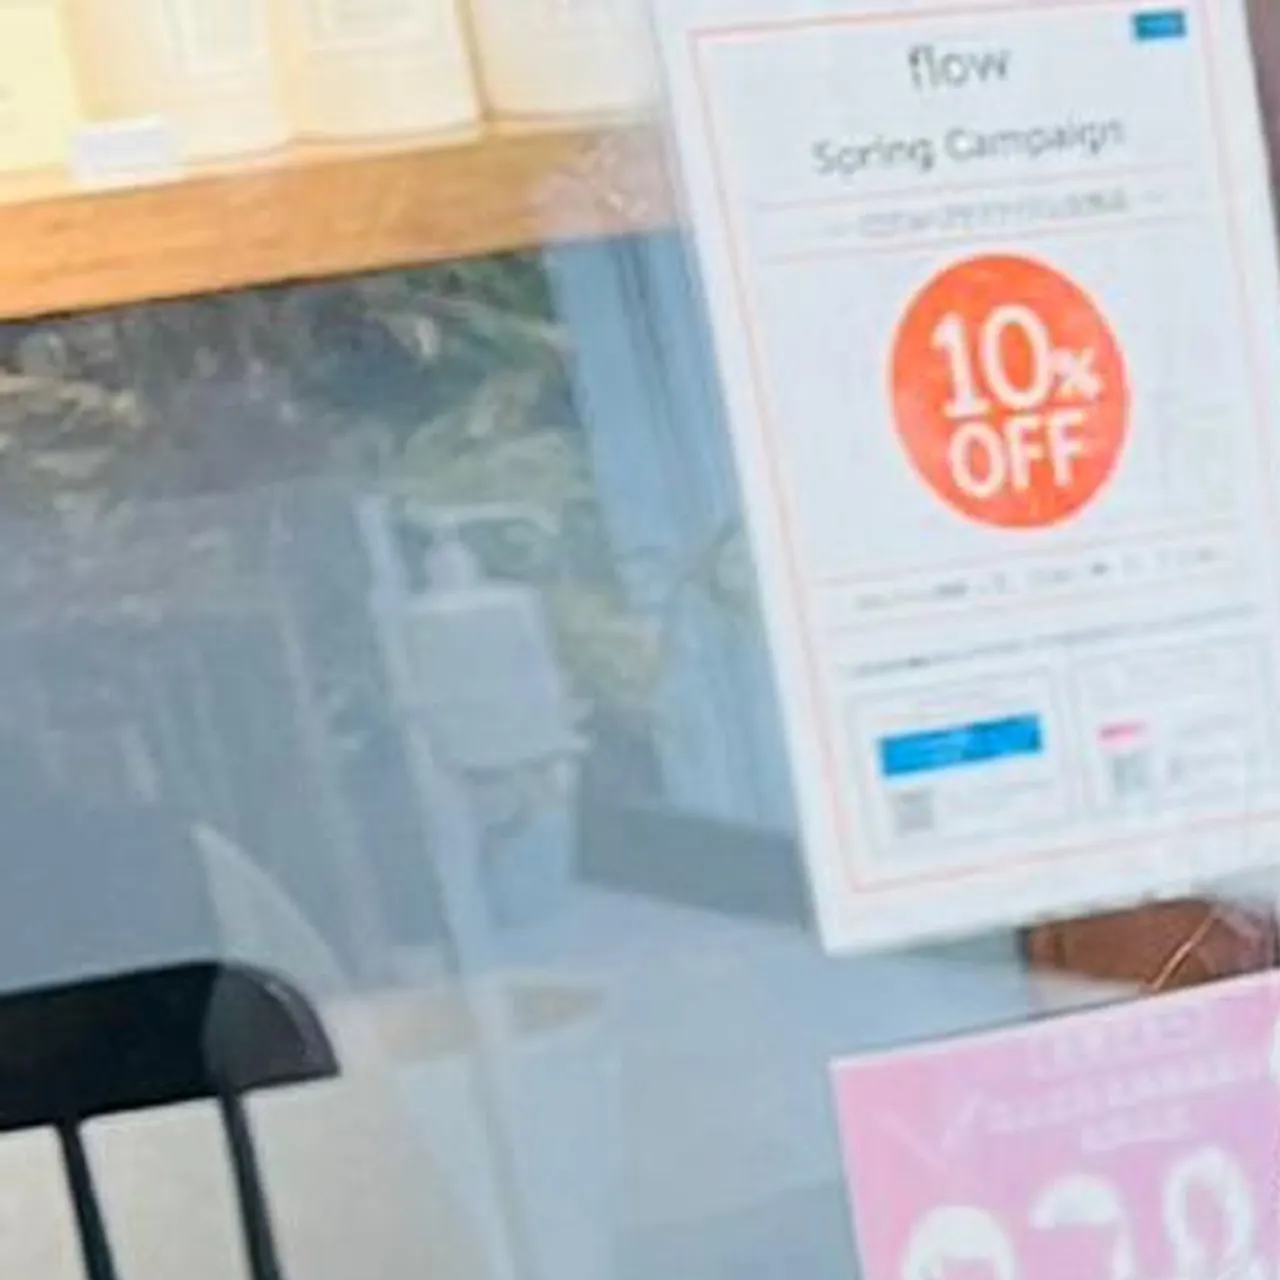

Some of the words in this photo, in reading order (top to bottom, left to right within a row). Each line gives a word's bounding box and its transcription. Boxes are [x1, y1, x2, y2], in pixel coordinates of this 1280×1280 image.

[908, 45, 1011, 90] flow
[812, 137, 935, 177] Spring
[945, 117, 1126, 163] Campaign
[931, 305, 1101, 419] 10%
[948, 411, 1087, 497] OFF
